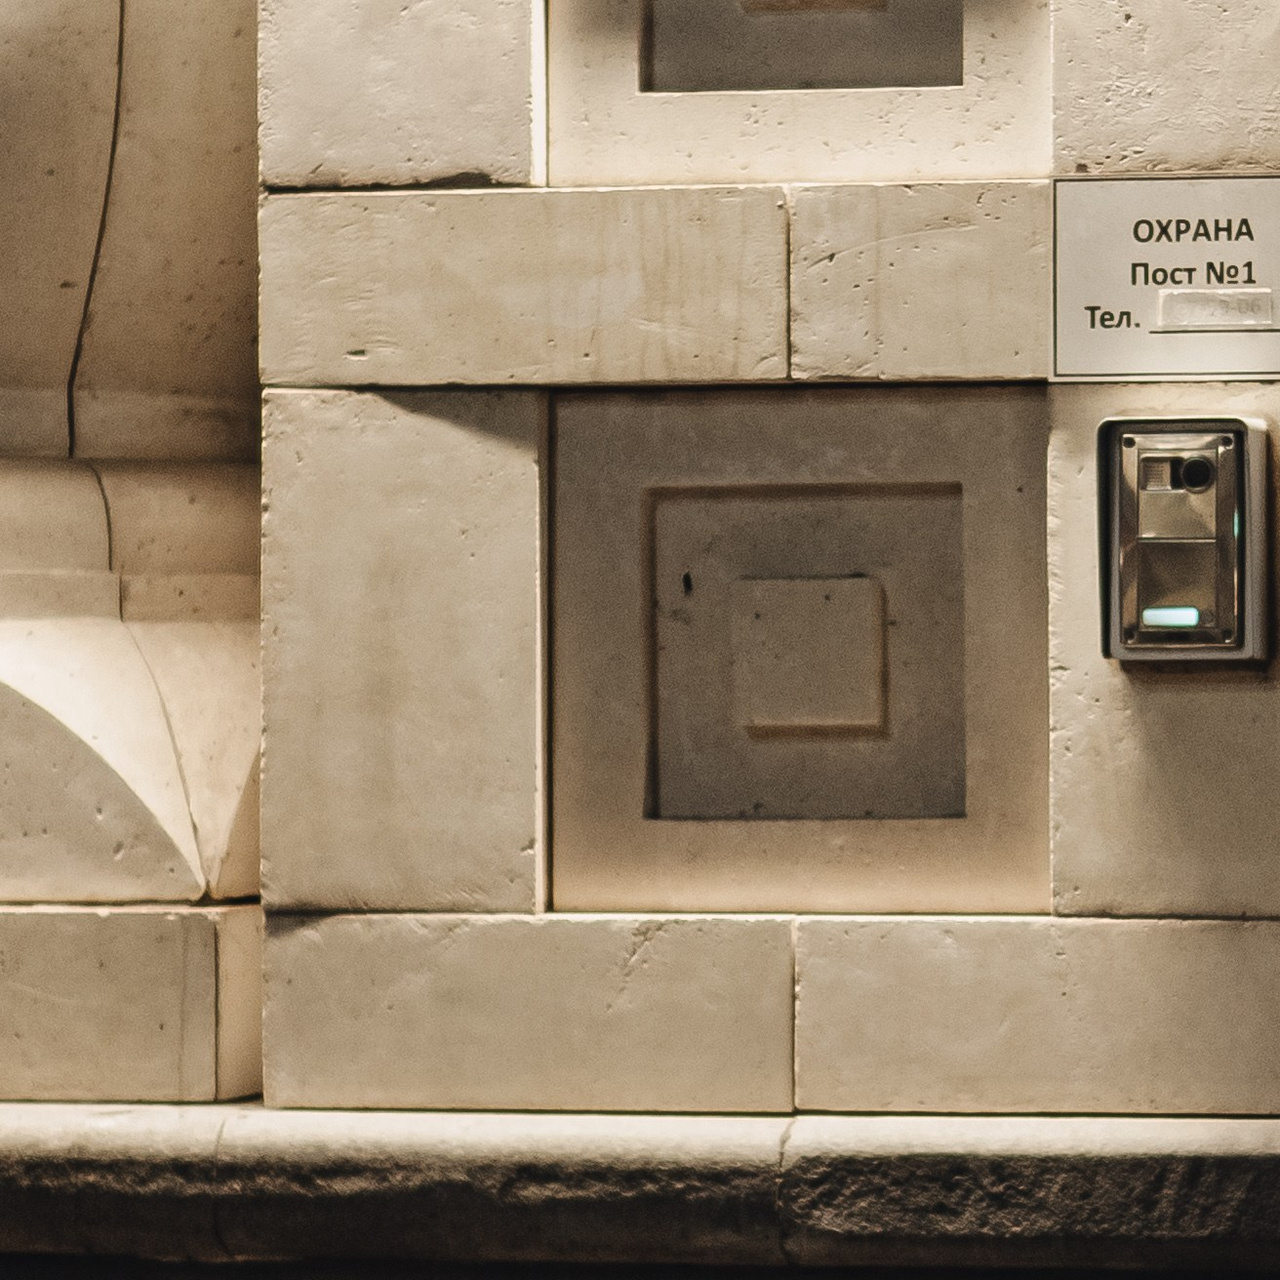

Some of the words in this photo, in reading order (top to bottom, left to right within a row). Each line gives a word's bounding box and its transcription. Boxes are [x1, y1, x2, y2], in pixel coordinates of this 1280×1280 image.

[1132, 218, 1255, 243] ОХРАНА
[1131, 262, 1197, 286] Пост
[1206, 261, 1257, 285] №1
[1084, 305, 1141, 329] Тел.
